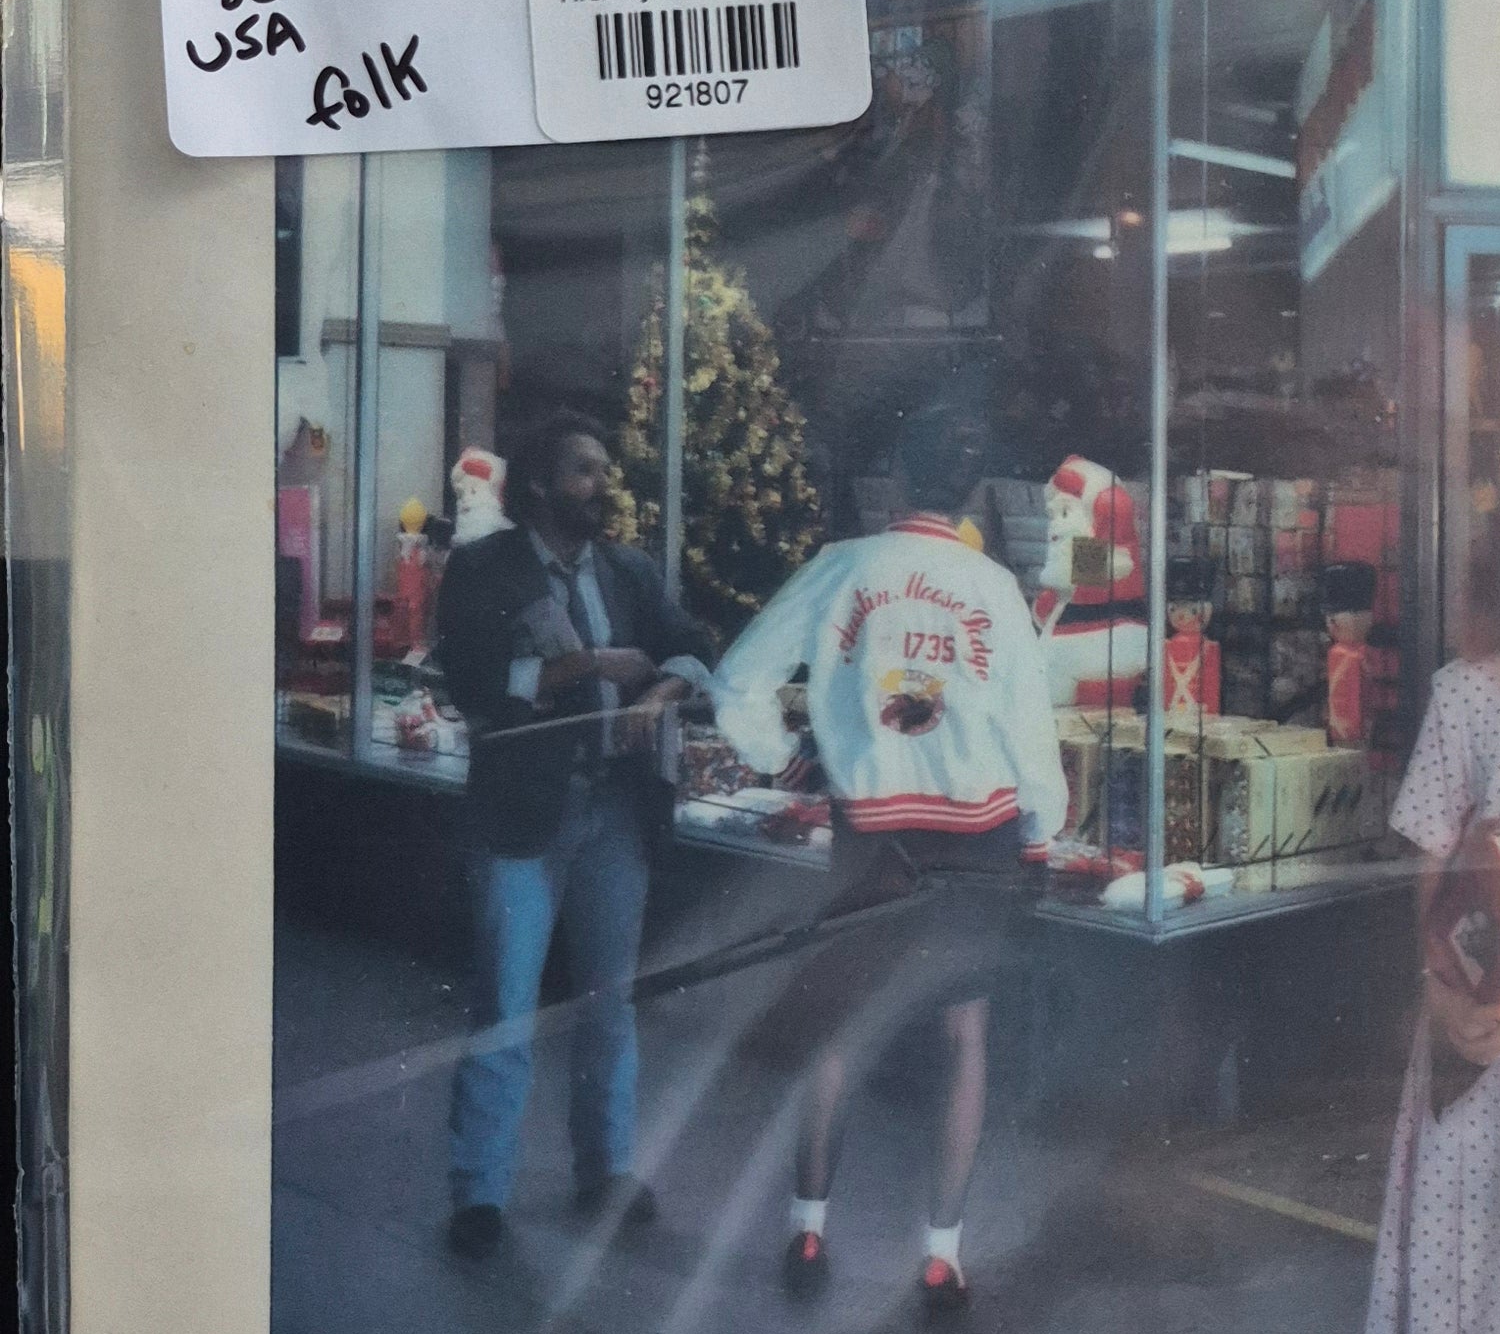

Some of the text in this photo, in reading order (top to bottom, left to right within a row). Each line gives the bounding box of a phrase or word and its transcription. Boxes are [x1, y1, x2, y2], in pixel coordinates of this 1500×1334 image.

[185, 13, 306, 72] USA
[645, 79, 750, 110] 921807
[903, 631, 957, 664] 1735
